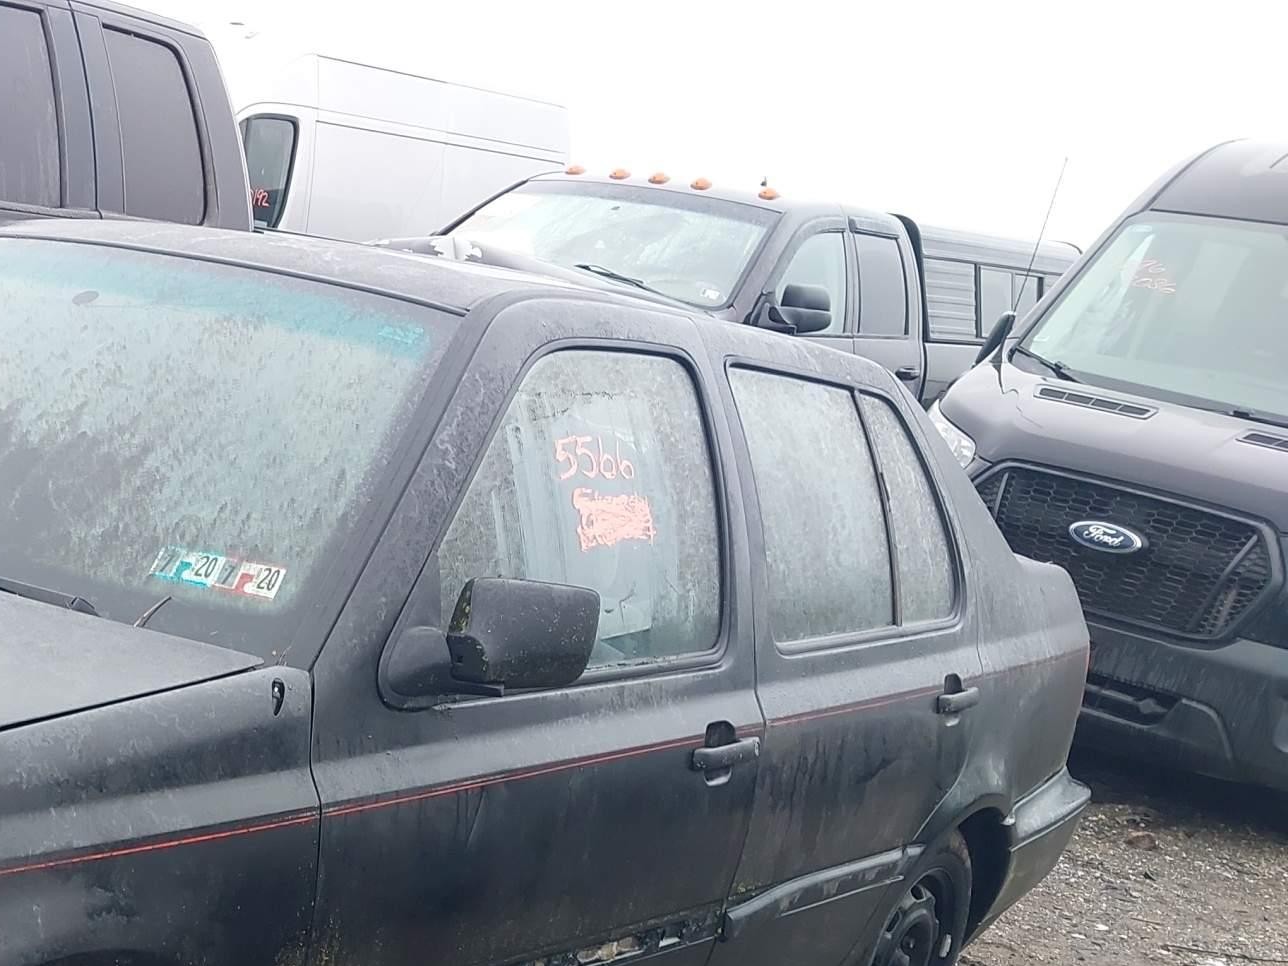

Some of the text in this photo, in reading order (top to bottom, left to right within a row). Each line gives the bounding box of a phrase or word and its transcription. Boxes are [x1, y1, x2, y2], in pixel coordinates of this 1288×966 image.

[555, 434, 634, 480] 5566
[1083, 525, 1124, 547] Ford
[194, 555, 218, 579] 20
[257, 567, 281, 592] 20
